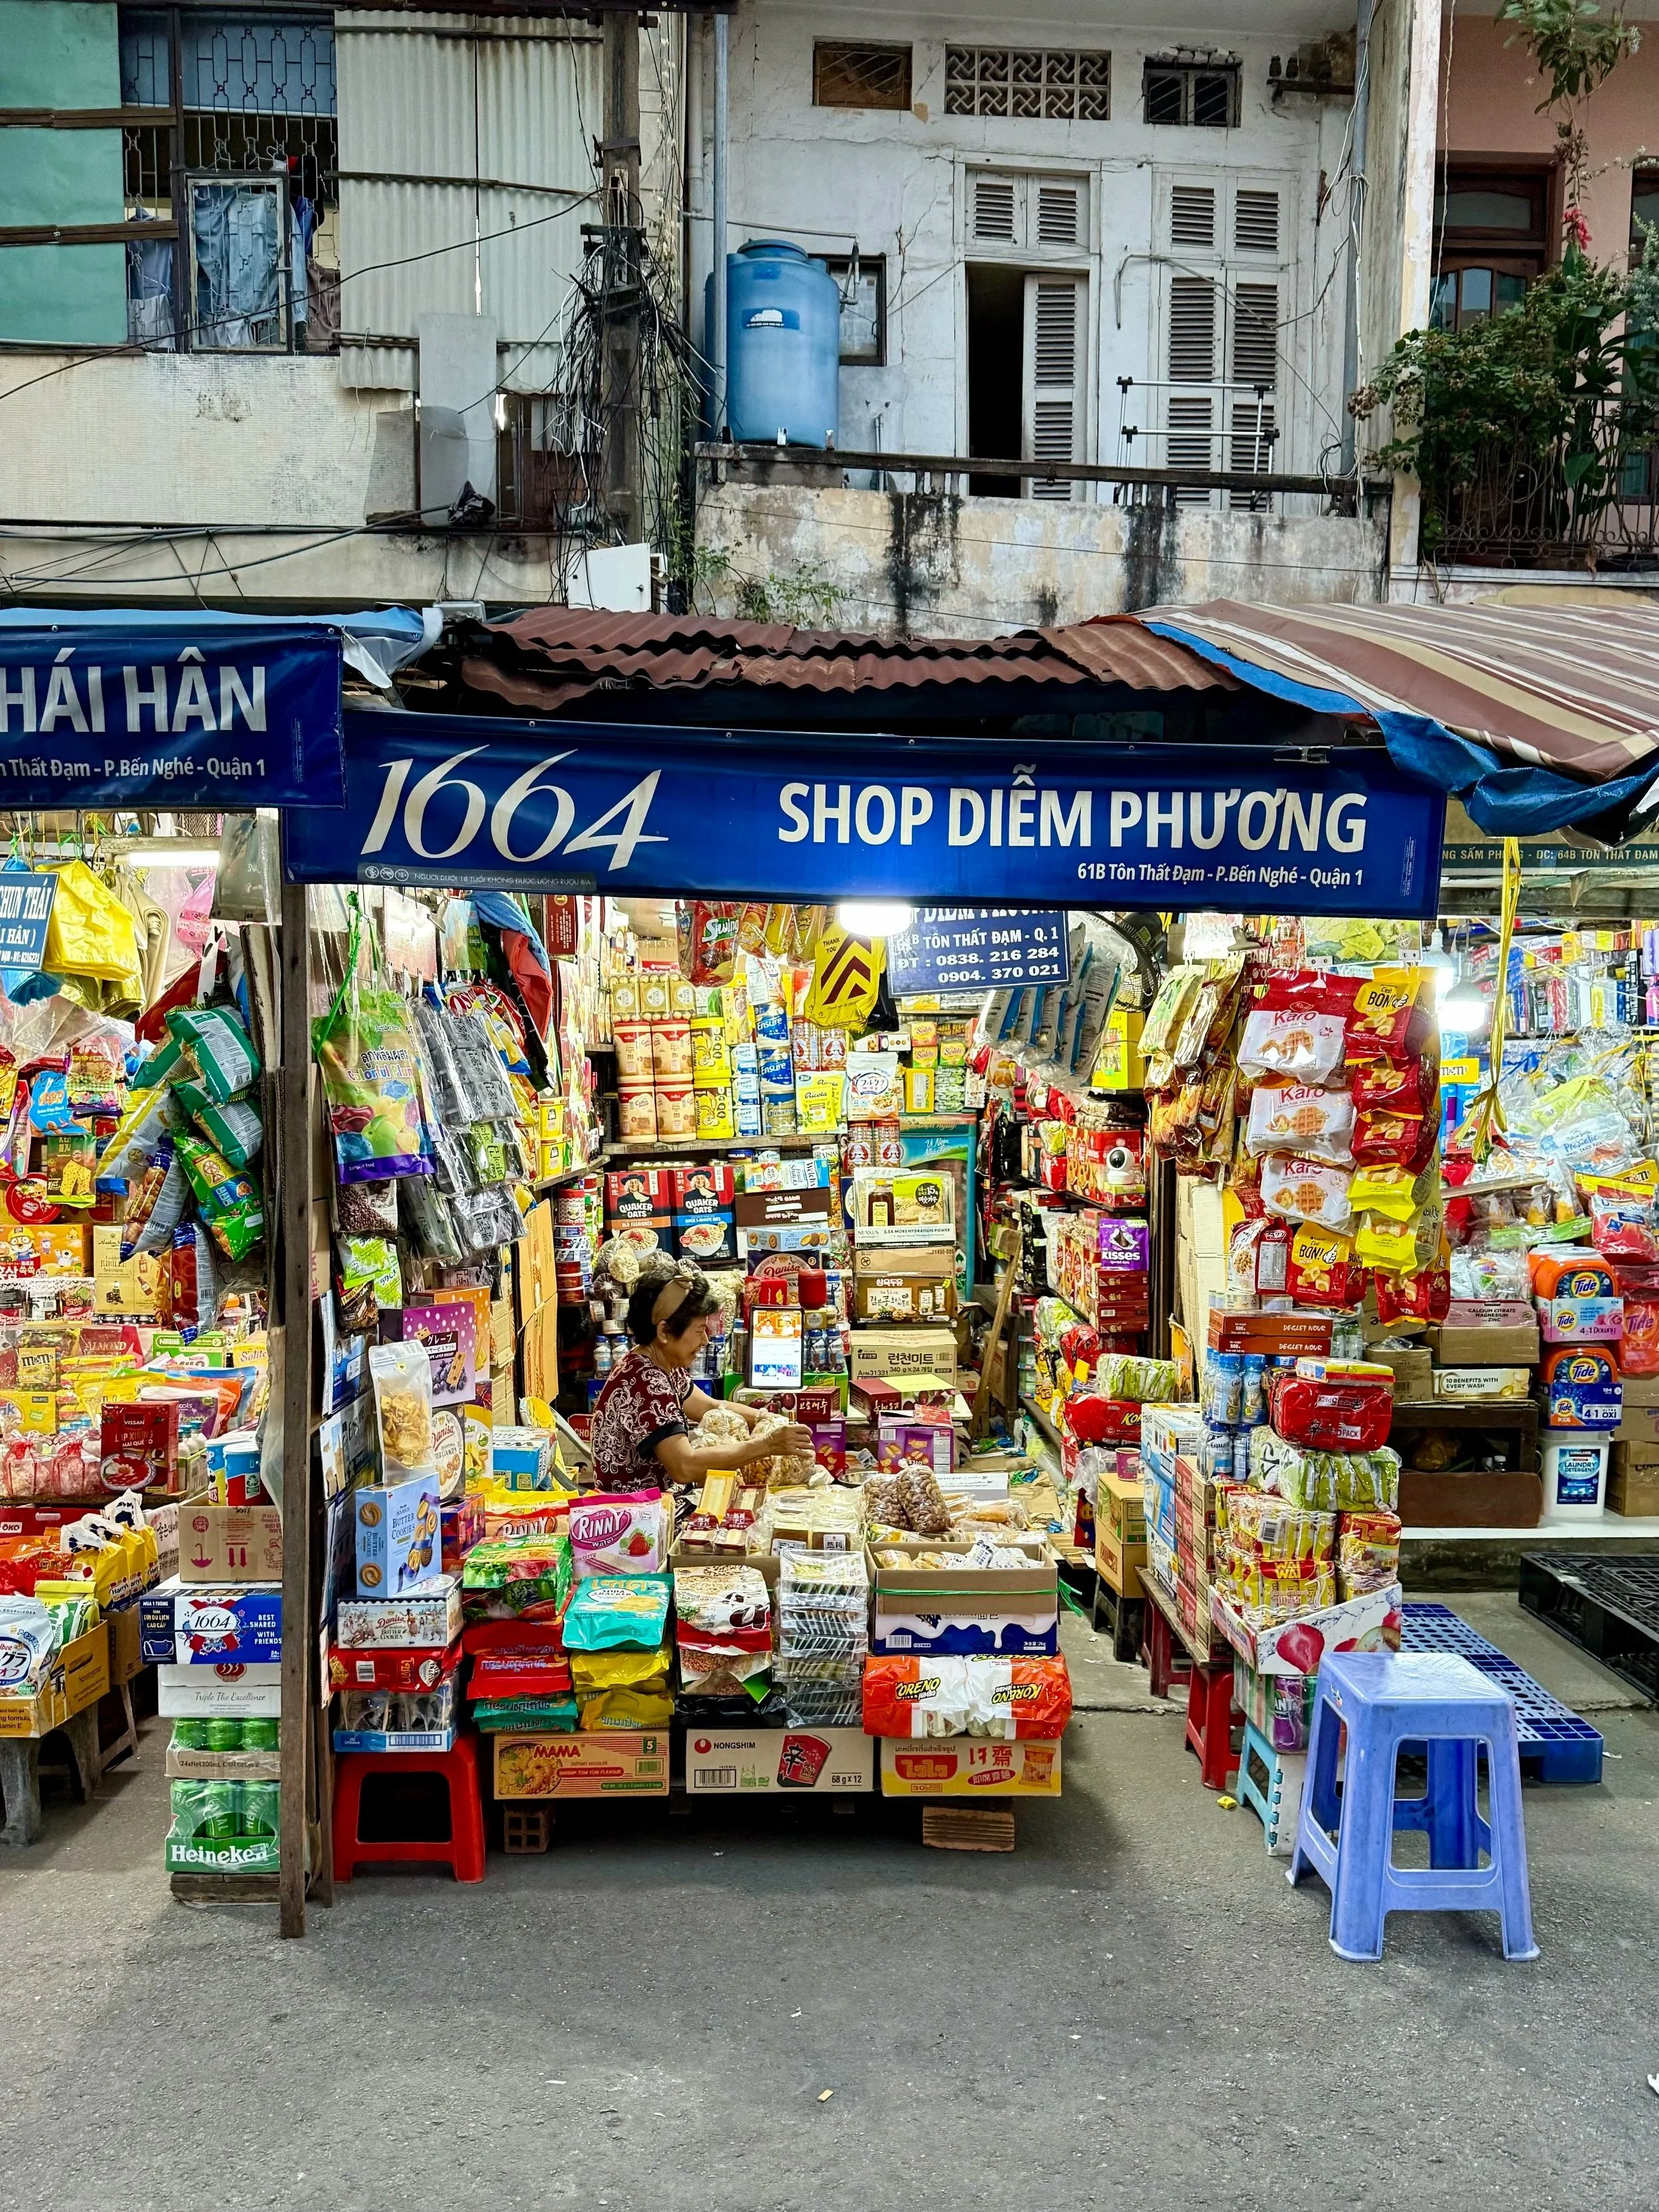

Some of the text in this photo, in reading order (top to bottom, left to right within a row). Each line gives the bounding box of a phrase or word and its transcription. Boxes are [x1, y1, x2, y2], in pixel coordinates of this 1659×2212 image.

[125, 646, 267, 732] HÂN
[9, 757, 47, 776] Thất
[50, 760, 90, 780] Đạm
[105, 757, 149, 777] P.Bến
[152, 757, 194, 780] Nghé
[207, 757, 249, 780] Quận
[257, 759, 265, 776] 1
[360, 744, 670, 872] 1664
[778, 763, 1367, 853] SHOP DIỄM PHƯƠNG
[1557, 849, 1576, 859] 64B
[1634, 849, 1659, 861] ĐẠM
[1078, 863, 1362, 889] 61B Tôn Thất Đạm P.Bến Nghé Quận 1
[23, 877, 52, 920] THÁI
[6, 924, 31, 945] HÂN
[923, 926, 1059, 950] TÔN THẤT ĐẠM Q. 1
[822, 937, 839, 948] THANK
[936, 953, 984, 966] 0838.
[989, 950, 1021, 962] 216
[1027, 946, 1059, 960] 284
[938, 964, 1060, 983] 0904. 370 021
[757, 1016, 782, 1029] Ensure
[1273, 1011, 1319, 1026] Karo
[916, 1050, 935, 1059] Solite
[944, 1047, 962, 1057] Solite
[346, 1064, 392, 1082] Colorful
[760, 1063, 786, 1075] Ensure
[1279, 1087, 1325, 1100] Karo
[619, 1203, 653, 1213] QUAKER
[685, 1199, 719, 1208] QUAKER
[1101, 1250, 1141, 1261] KISSES
[1299, 1245, 1323, 1259] BON!
[763, 1263, 802, 1278] Danisa
[1574, 1280, 1597, 1294] Tide
[1557, 1315, 1574, 1327] Tide
[1626, 1315, 1654, 1334] Tide
[1593, 1326, 1616, 1335] Downy
[87, 1341, 127, 1351] ALMOND
[427, 1333, 453, 1346] グレープ
[887, 1353, 934, 1365] 런천미트
[1572, 1364, 1595, 1377] Tide
[1557, 1402, 1572, 1412] Tide
[1210, 1439, 1231, 1448] Ensure
[392, 1512, 415, 1528] BUTTER
[577, 1511, 626, 1541] RINNY
[392, 1524, 415, 1539] COOKIES
[1275, 1569, 1301, 1579] WAI
[194, 1613, 232, 1629] 1664
[376, 1615, 405, 1629] Danisa
[895, 1677, 941, 1701] KORENO
[195, 1692, 214, 1702] Triple
[230, 1692, 266, 1702] Excellence
[533, 1744, 581, 1759] MAMA
[646, 1740, 654, 1750] 5
[713, 1741, 756, 1750] NONGSHIM
[831, 1775, 841, 1784] 68
[853, 1775, 862, 1784] 12
[171, 1844, 269, 1864] Heineken
